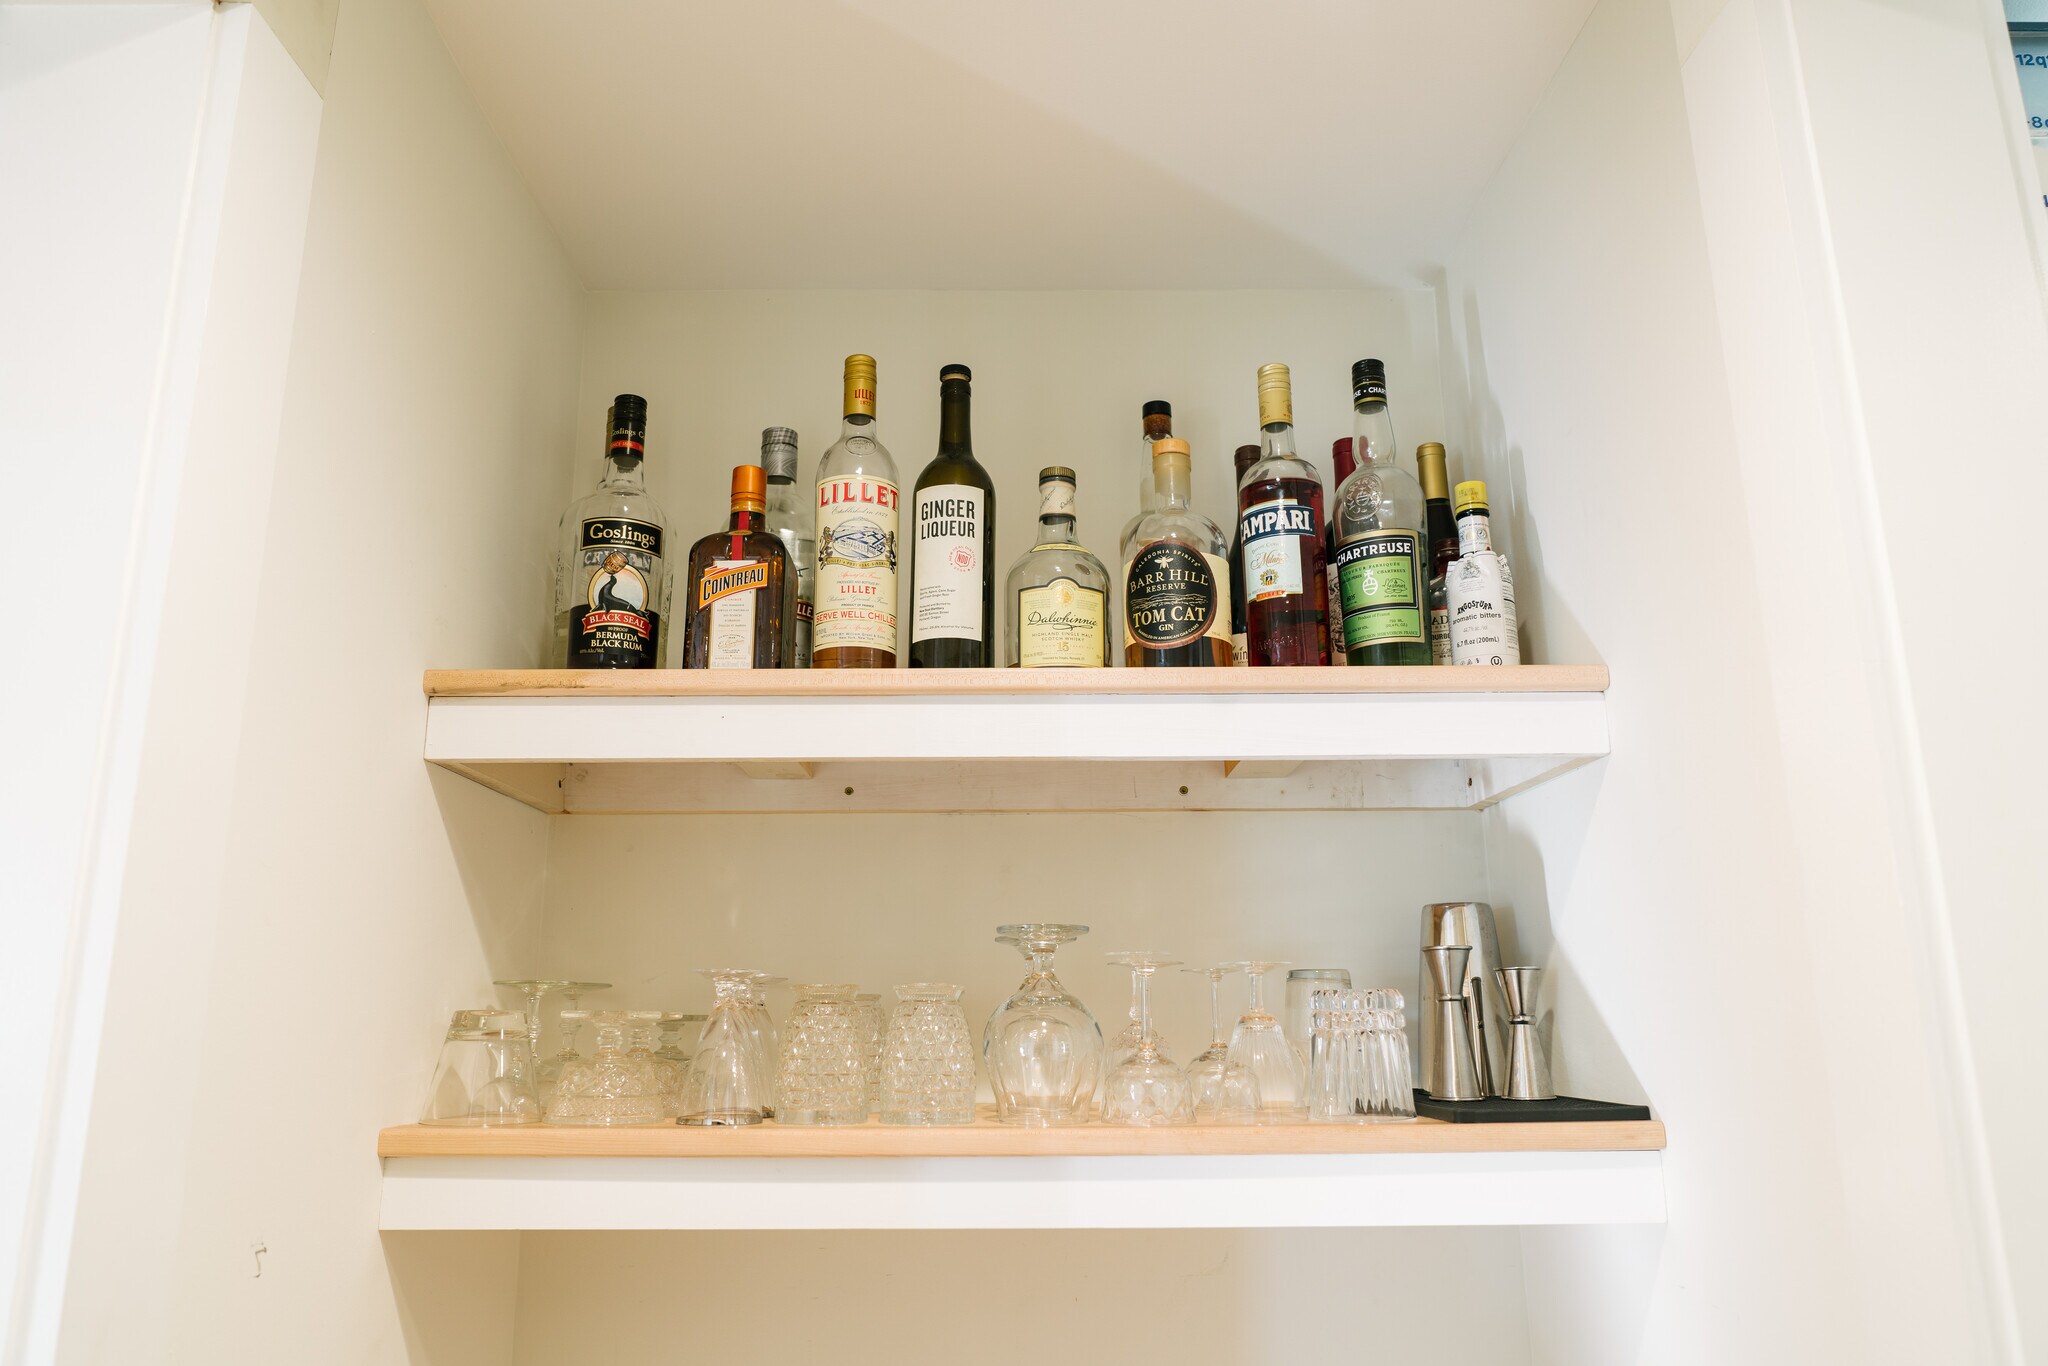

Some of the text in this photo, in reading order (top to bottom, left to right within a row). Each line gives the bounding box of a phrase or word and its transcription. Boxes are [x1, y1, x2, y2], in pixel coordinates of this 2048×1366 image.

[820, 482, 898, 512] LILLET
[922, 499, 975, 520] GINGER
[590, 524, 656, 548] Goslings
[921, 520, 975, 540] LIQUEUR
[1136, 550, 1200, 572] CALEDONIA SPIRITS
[1337, 542, 1412, 566] CHARTREUSE
[704, 568, 764, 600] COINTREAU
[1130, 569, 1208, 593] BARR HILL
[1146, 582, 1186, 594] RESERVE
[841, 585, 876, 594] LILLET
[1457, 600, 1493, 615] ANGOSTURA
[590, 614, 645, 628] BLACK SEAL
[816, 612, 838, 622] SERVE
[840, 610, 866, 618] WELL
[1028, 611, 1097, 627] Dalwhinnie
[1133, 606, 1206, 628] TOM CAT
[1452, 611, 1502, 625] aromatic bitters
[1158, 624, 1174, 632] GIN
[596, 632, 638, 642] BERMUDA
[591, 640, 642, 652] BLACK RUM
[1057, 641, 1070, 652] 15
